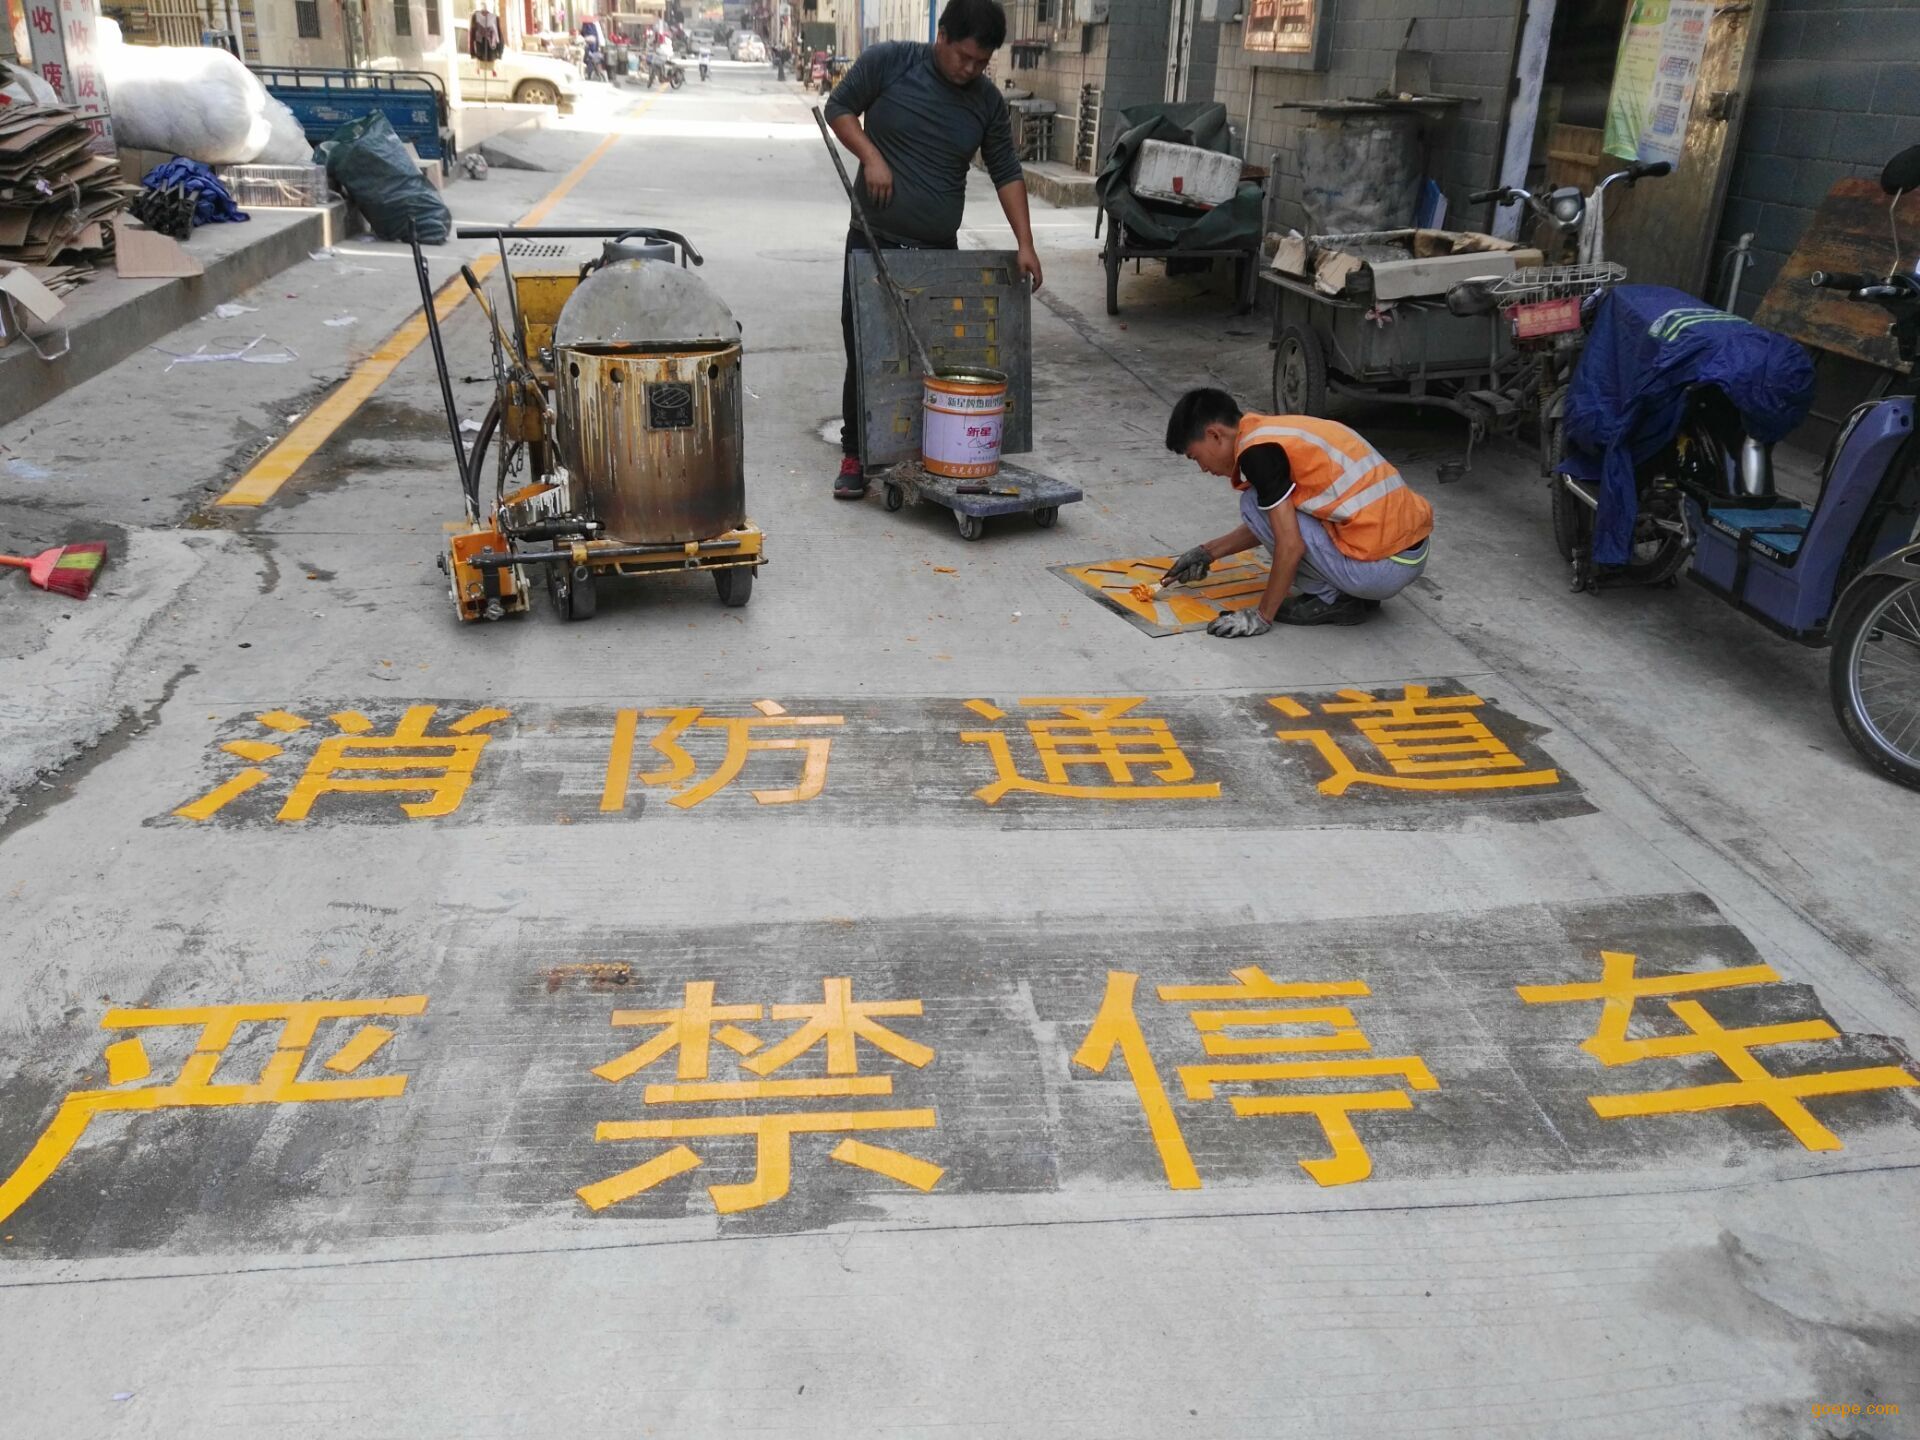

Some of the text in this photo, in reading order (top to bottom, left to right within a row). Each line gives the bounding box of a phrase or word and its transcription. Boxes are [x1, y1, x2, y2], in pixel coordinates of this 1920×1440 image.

[172, 683, 1560, 822] 消防通道
[0, 950, 1920, 1224] 严禁停车
